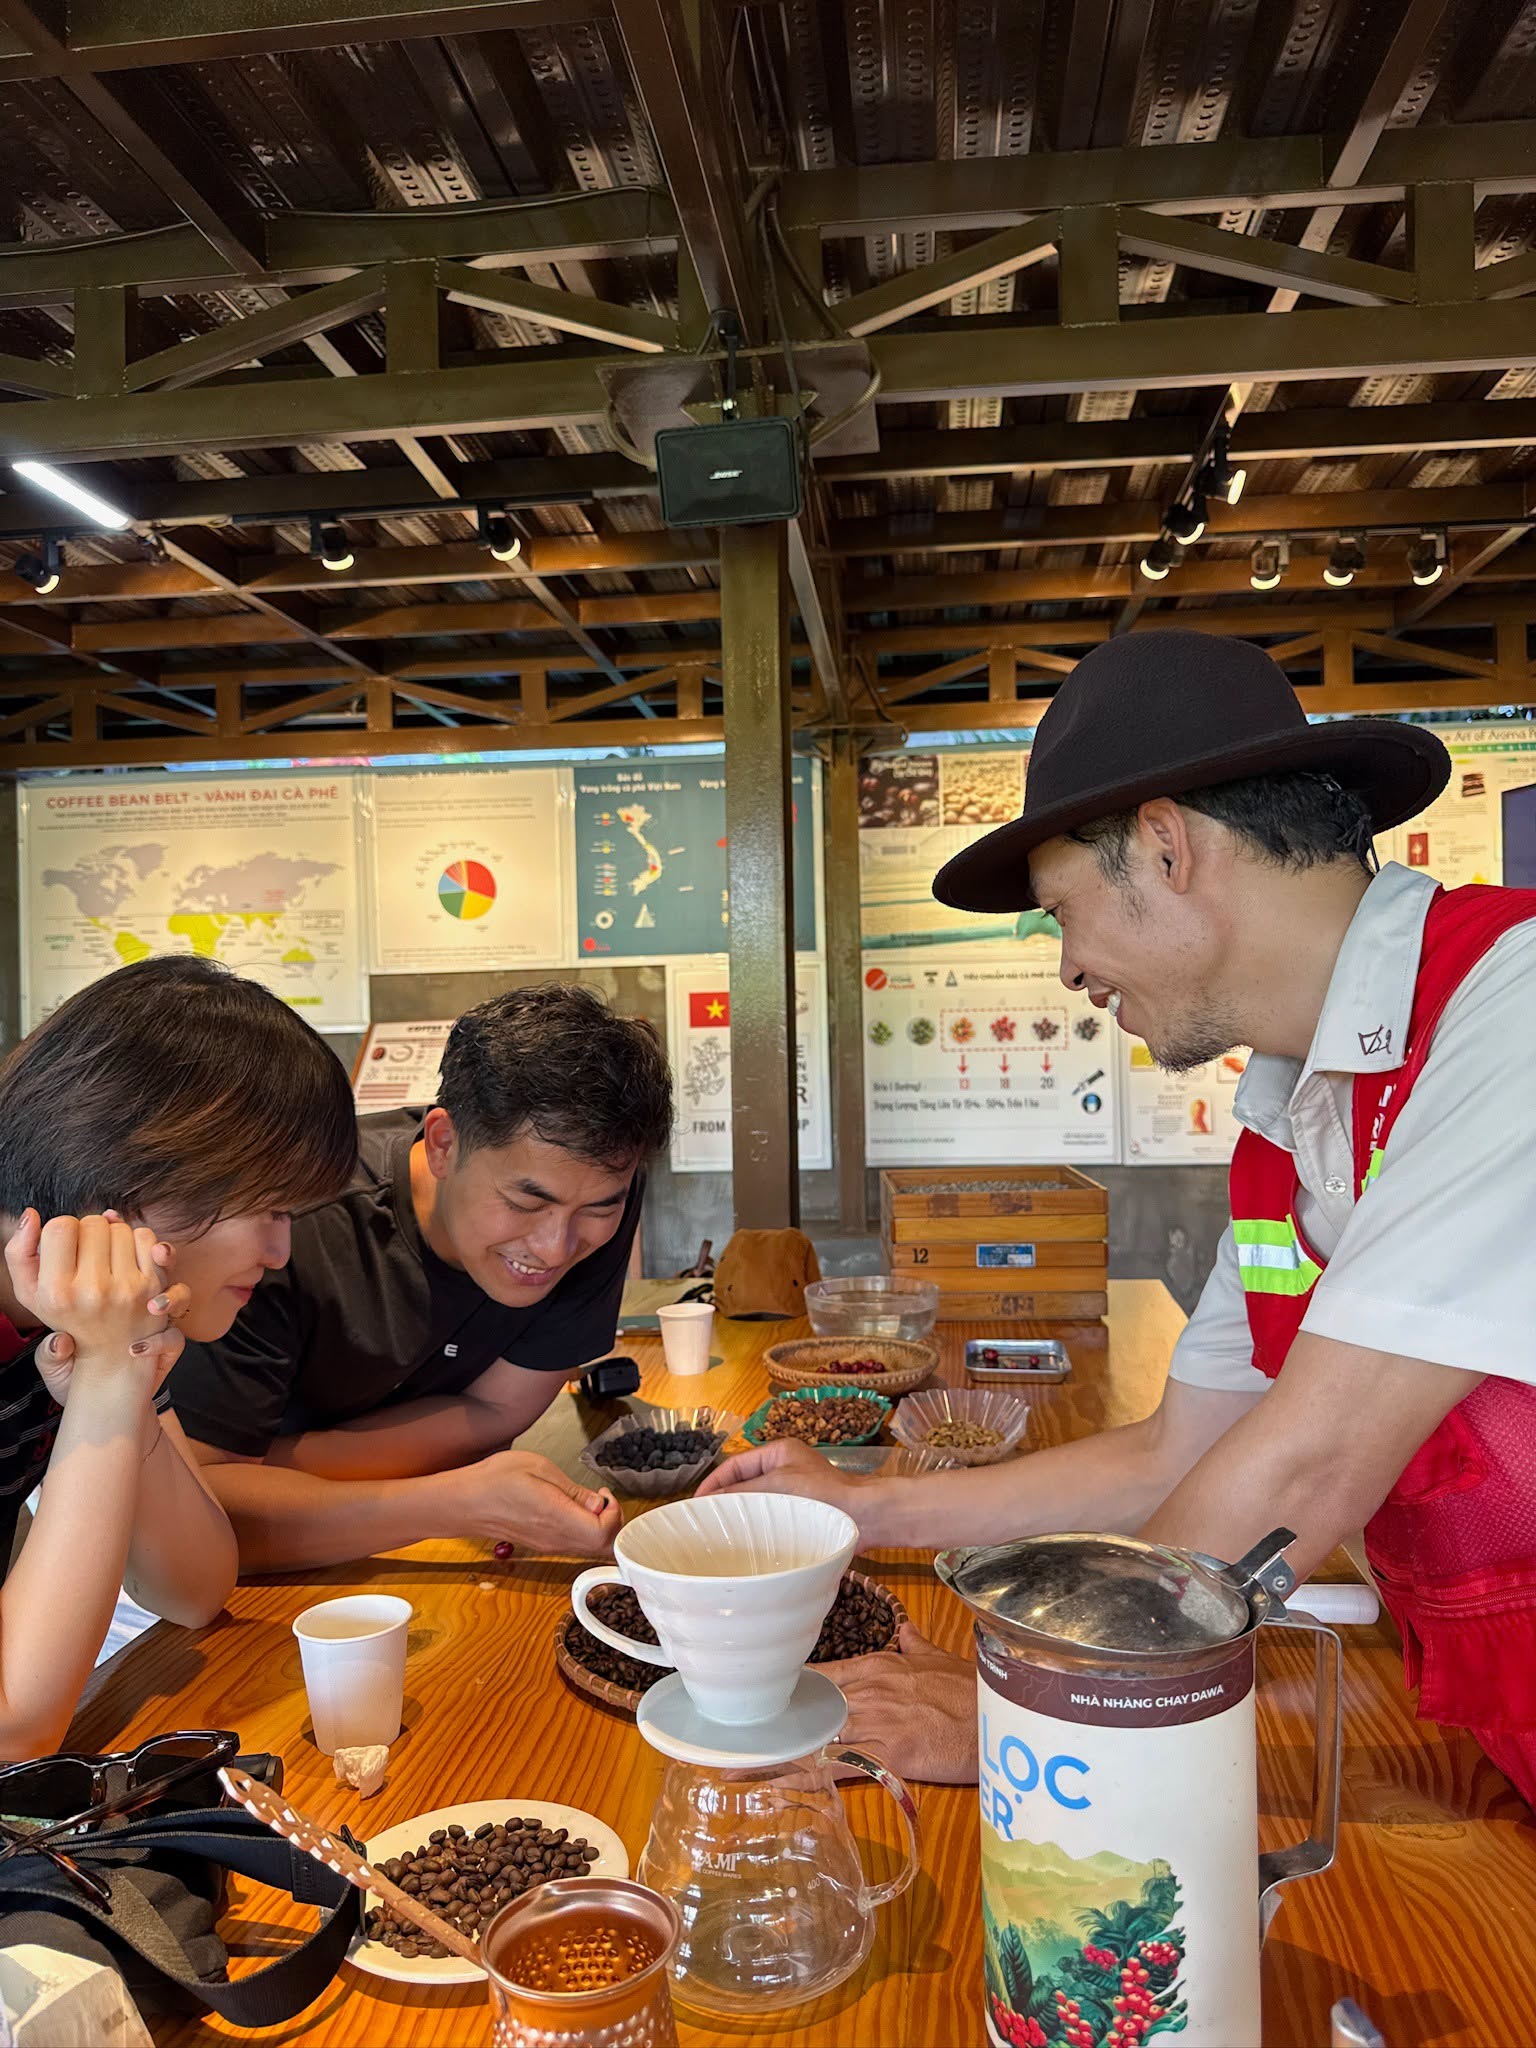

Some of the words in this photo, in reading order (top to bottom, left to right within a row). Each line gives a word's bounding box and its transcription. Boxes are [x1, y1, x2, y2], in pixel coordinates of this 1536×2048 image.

[46, 795, 104, 809] COFFEE
[108, 793, 150, 807] BEAN
[154, 791, 190, 805] BELT
[204, 788, 246, 802] VÀNH
[282, 785, 304, 800] CÀ
[308, 784, 338, 800] PHÊ
[1040, 1077, 1053, 1089] 20
[692, 1120, 726, 1132] FROM
[912, 1247, 929, 1264] 12
[1070, 1693, 1101, 1706] NHÀ
[1103, 1695, 1153, 1709] NHÀNG
[1155, 1692, 1190, 1708] CHAY
[1191, 1683, 1225, 1703] DAWA
[807, 1877, 820, 1890] 400
